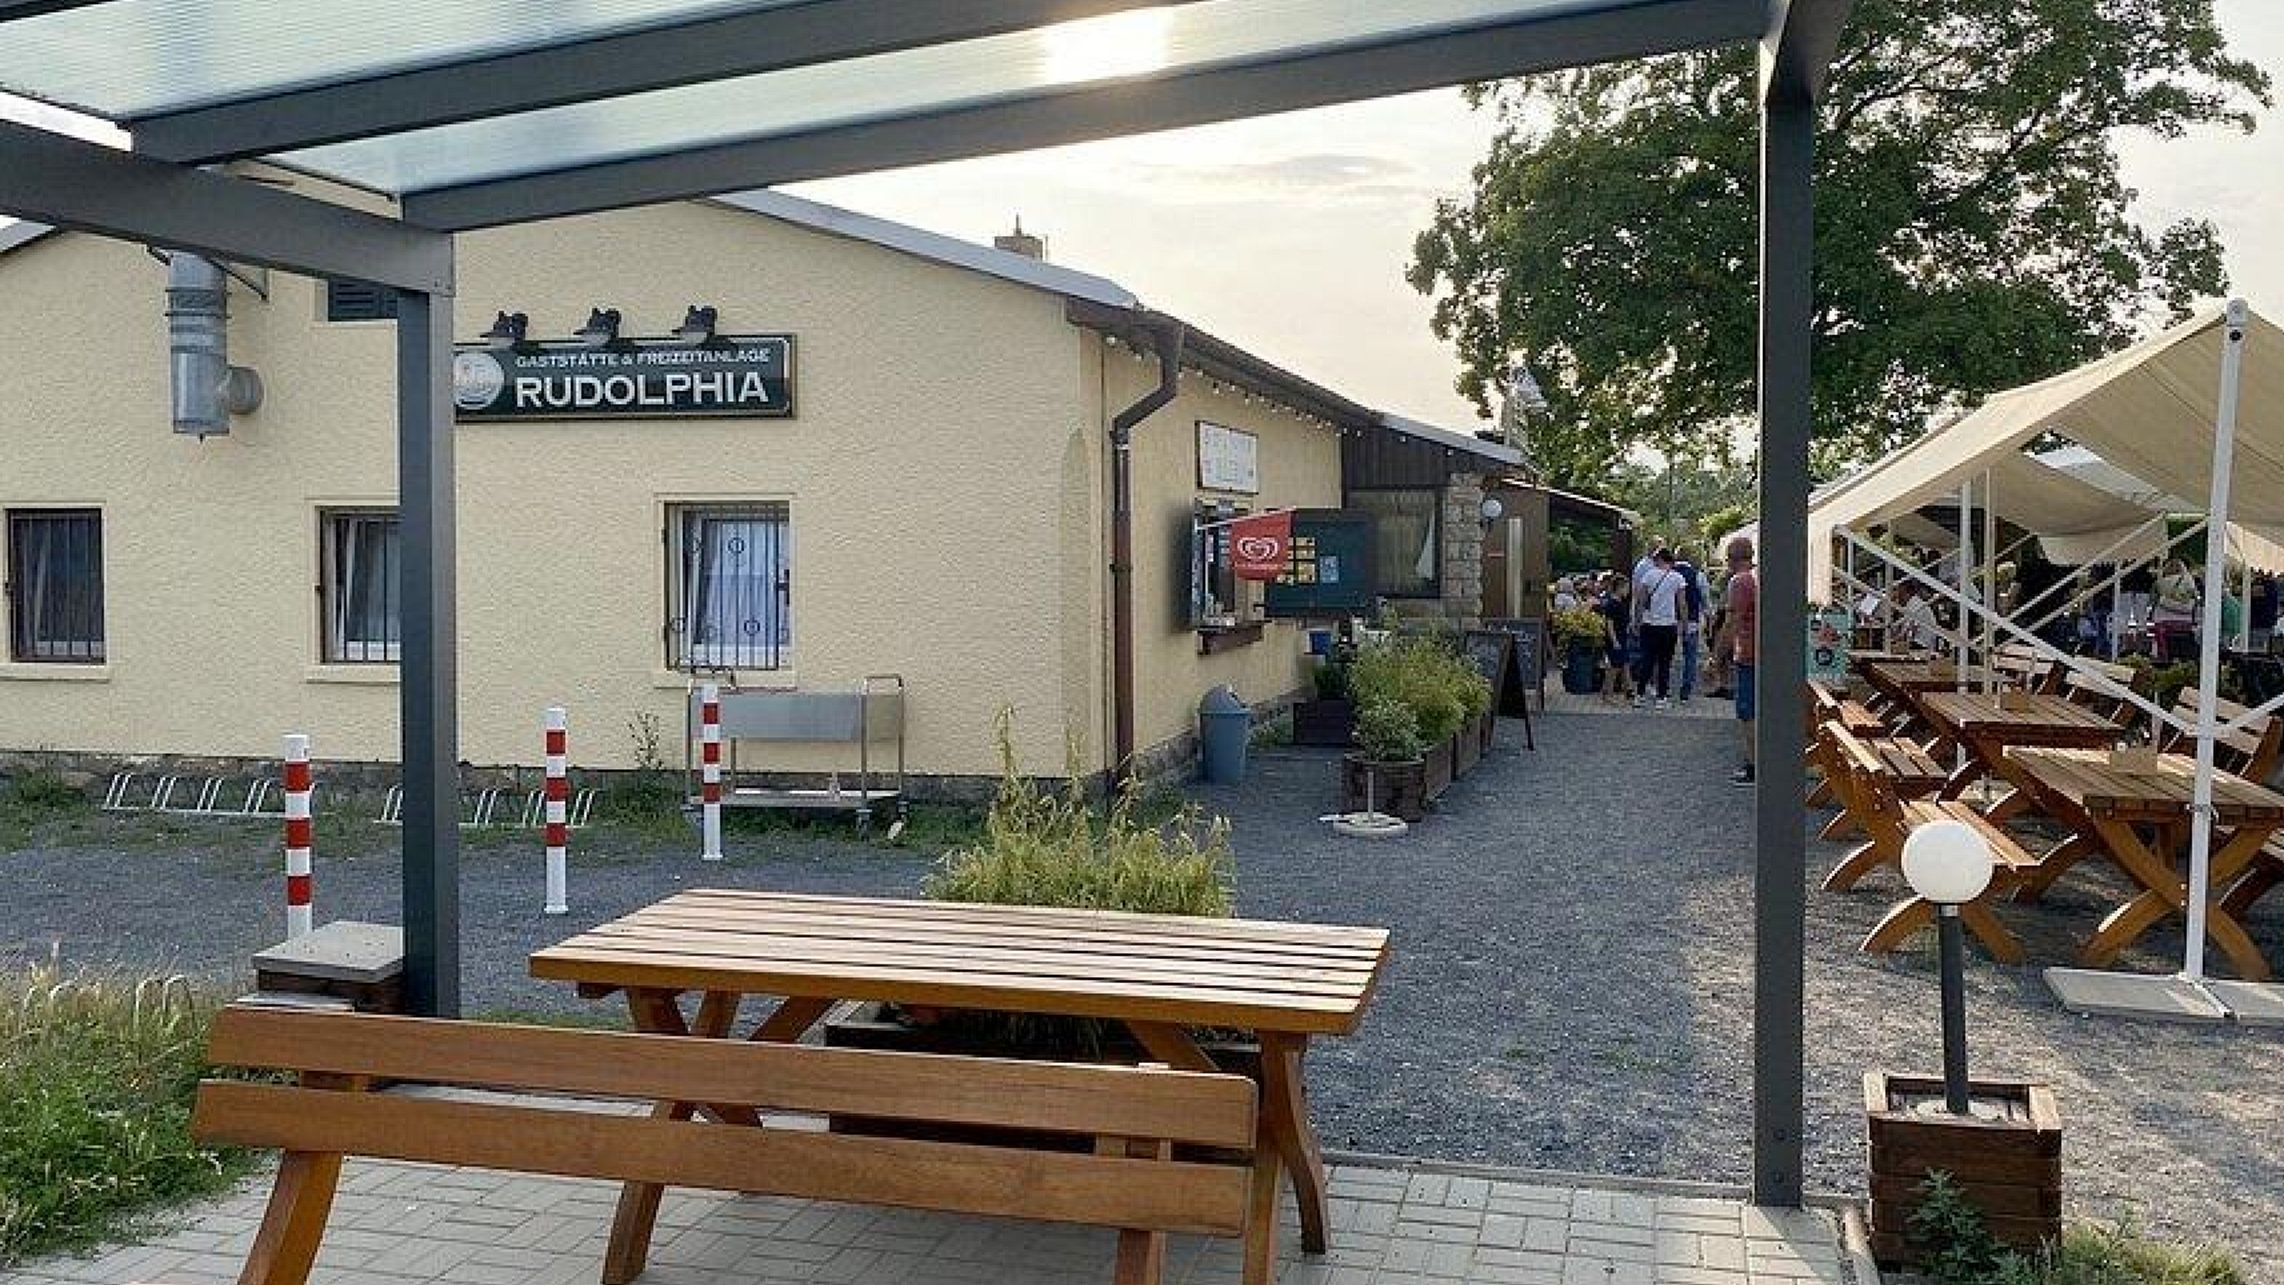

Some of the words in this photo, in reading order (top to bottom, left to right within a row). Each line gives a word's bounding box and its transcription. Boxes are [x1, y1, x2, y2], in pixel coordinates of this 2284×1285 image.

[515, 353, 618, 368] GASTSTÄTTE
[621, 354, 633, 365] &
[636, 348, 771, 366] FREIZEITANLAGE
[515, 371, 769, 408] RUDOLPHIA
